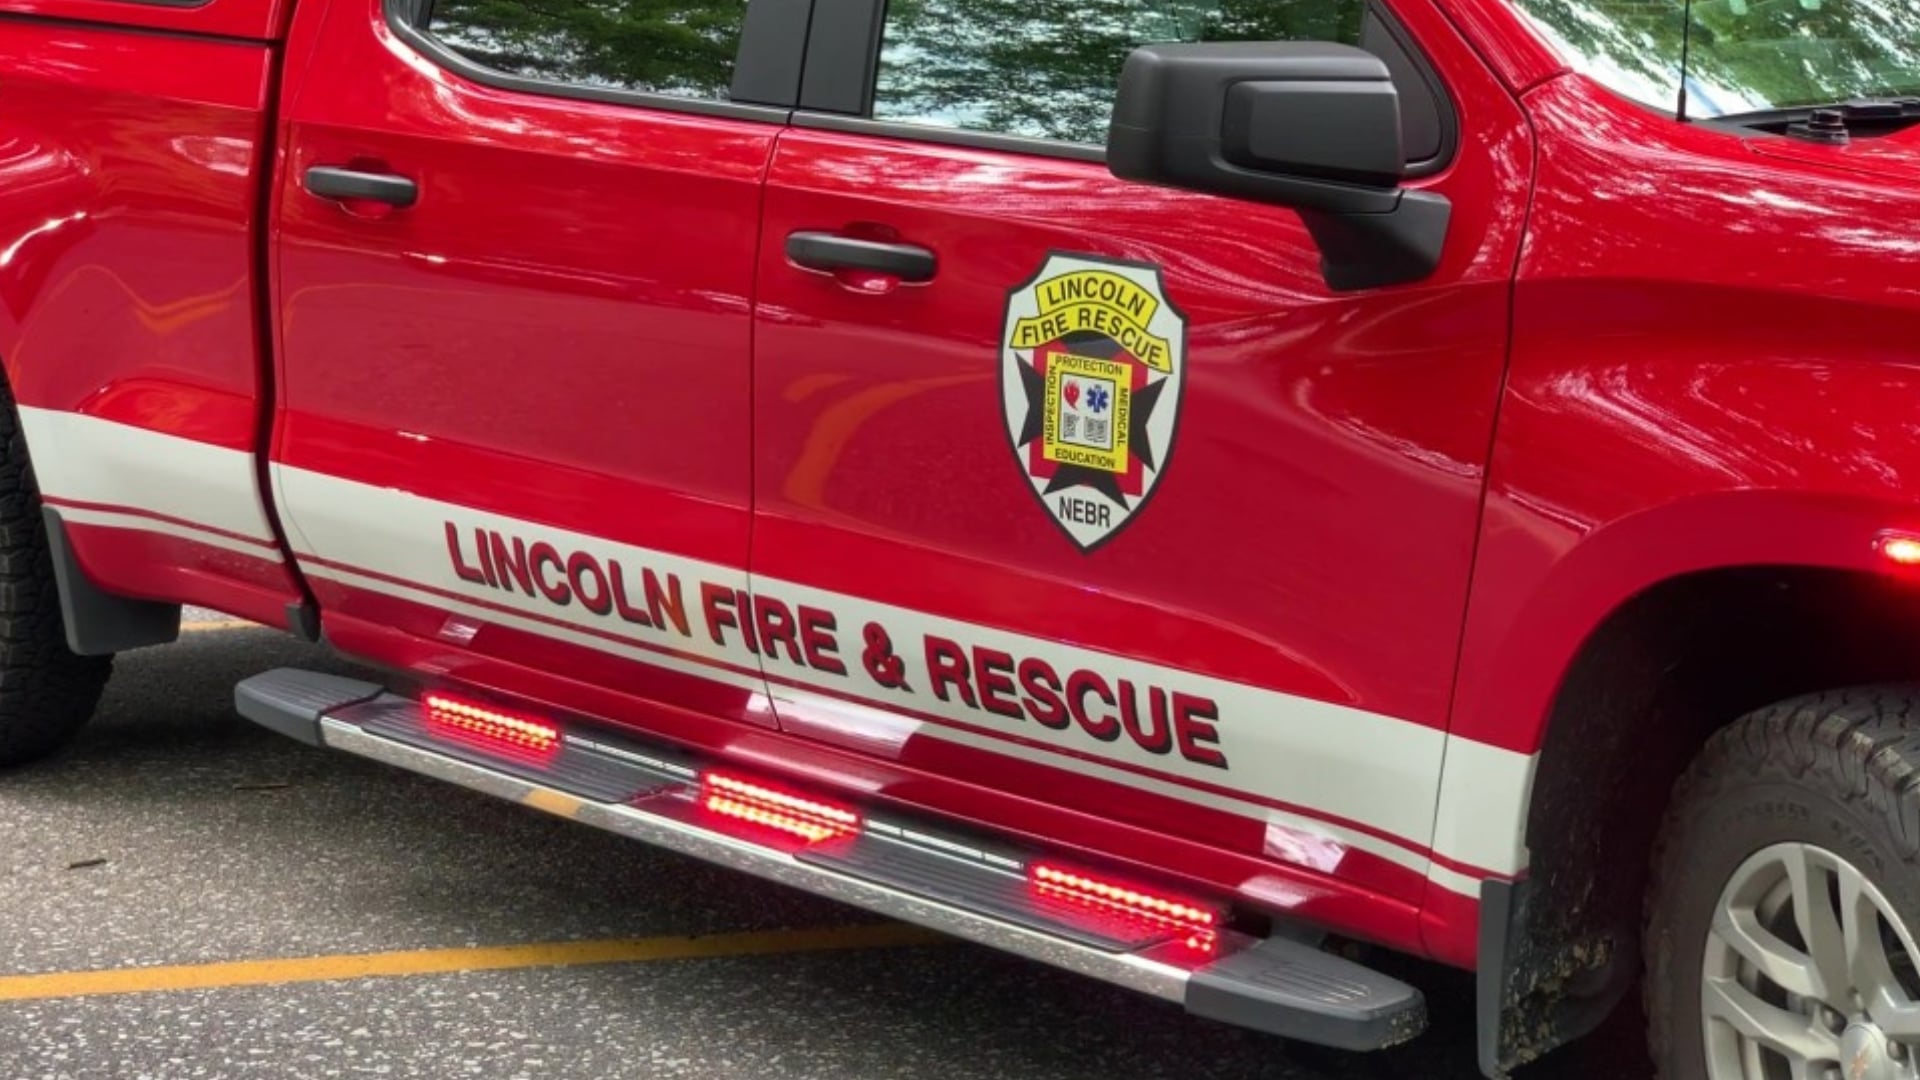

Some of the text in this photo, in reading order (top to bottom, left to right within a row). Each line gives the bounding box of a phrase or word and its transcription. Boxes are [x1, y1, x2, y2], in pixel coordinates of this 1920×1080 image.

[1047, 277, 1146, 317] LINCOLN
[1022, 307, 1162, 367] FIRE RESCUE
[1055, 355, 1122, 375] PROTECTION
[1045, 365, 1056, 445] INSPECTION
[1117, 388, 1129, 447] MEDICAL
[1055, 448, 1115, 468] EDUCATION
[1059, 496, 1111, 528] NEBR
[444, 521, 1229, 770] LINCOLN FIRE & RESCUE
